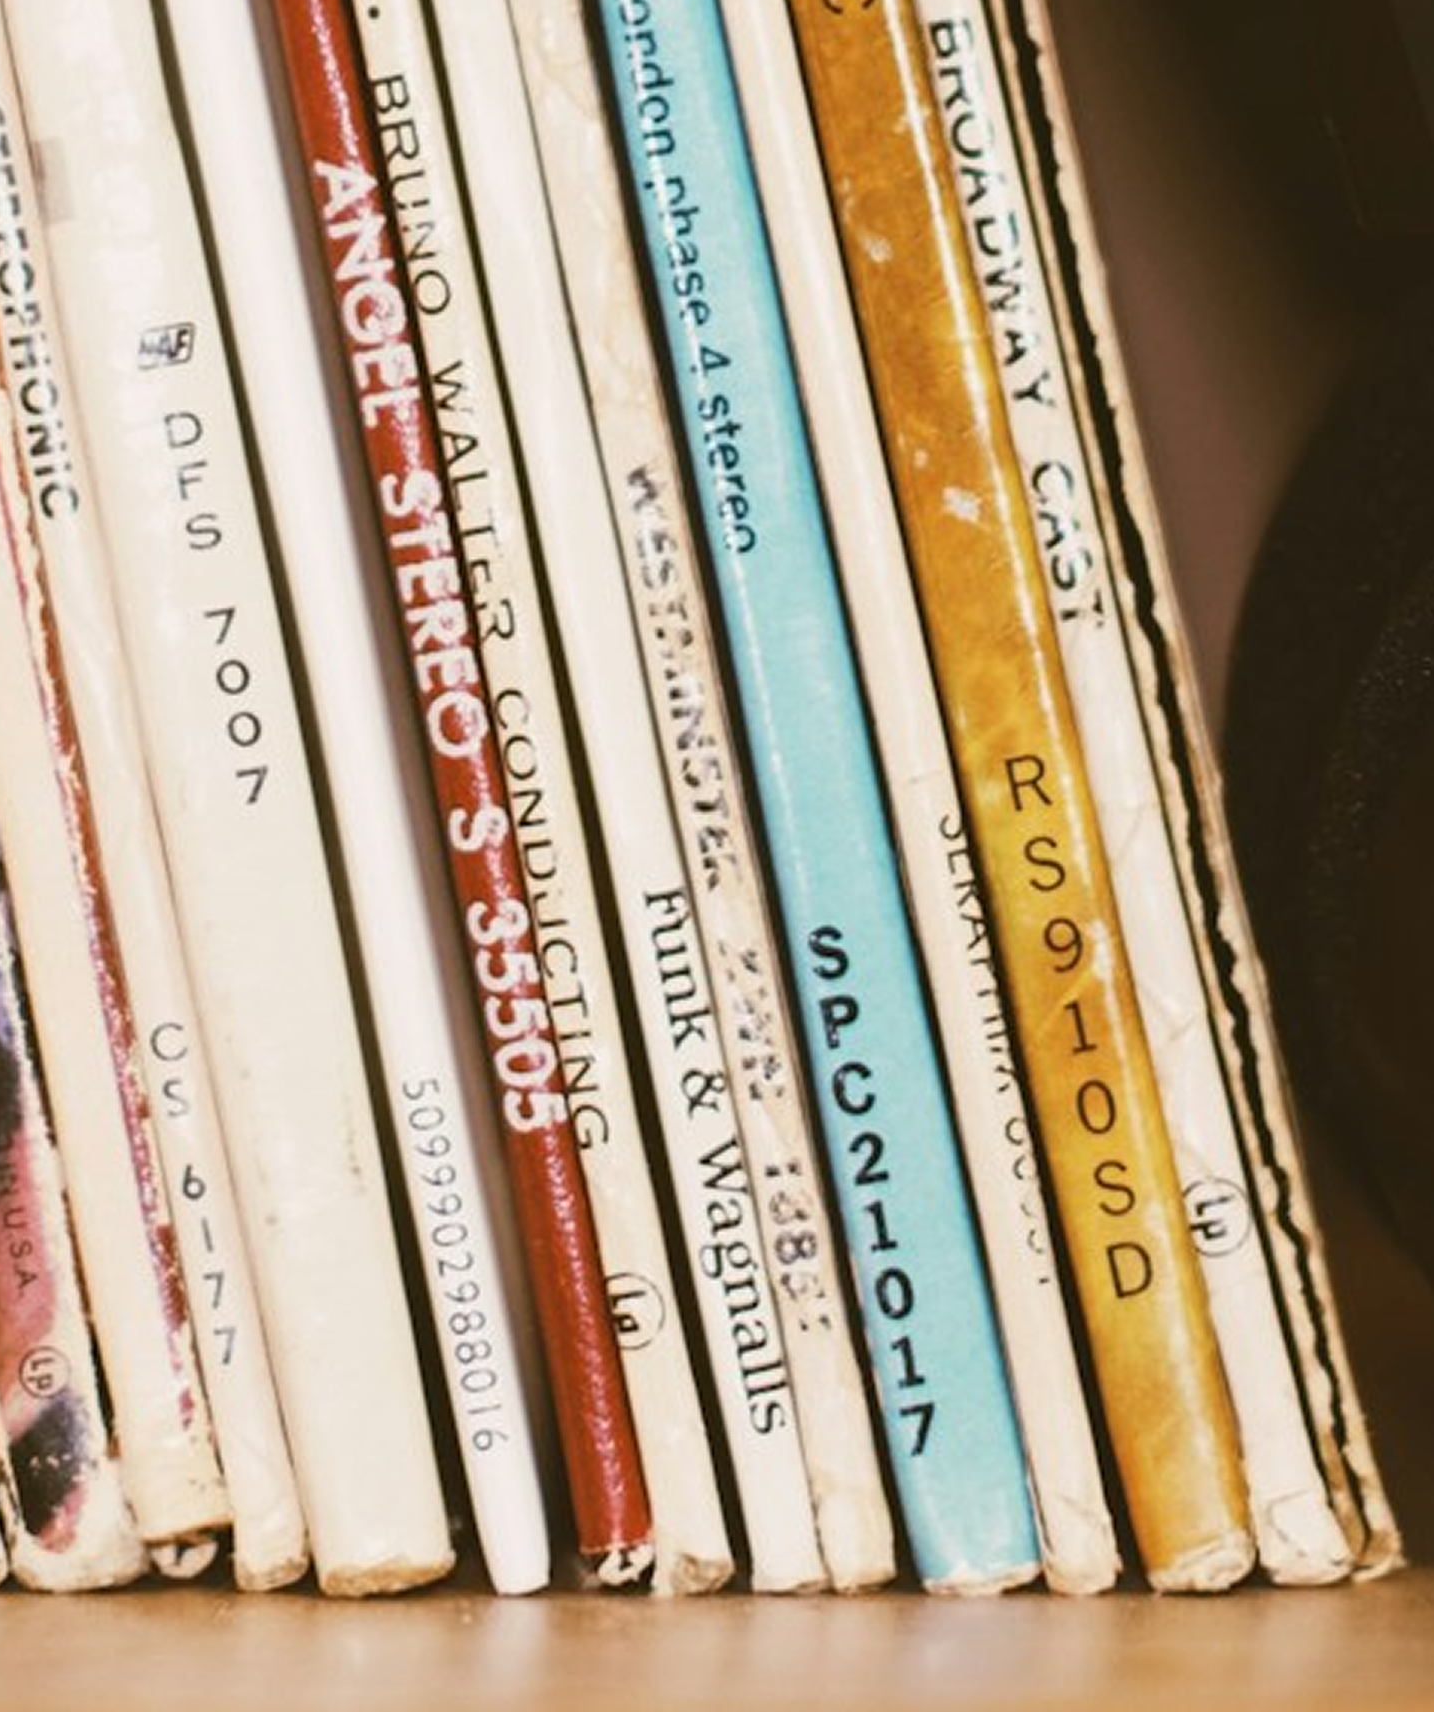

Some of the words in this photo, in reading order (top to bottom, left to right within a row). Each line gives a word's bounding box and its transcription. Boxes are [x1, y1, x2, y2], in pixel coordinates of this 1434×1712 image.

[313, 159, 422, 429] ANGEL
[642, 176, 710, 327] phase
[690, 345, 731, 378] 4
[695, 394, 758, 556] stereo
[1030, 461, 1107, 630] CAST
[367, 74, 451, 318] BRUNO
[428, 359, 515, 642] WALTER
[492, 688, 609, 1152] CONDUCTING
[378, 471, 490, 761] STEREO
[446, 807, 512, 854] S
[465, 899, 569, 1135] 35505
[643, 888, 707, 1051] Funk
[679, 1067, 726, 1118] &
[400, 1078, 509, 1452] 5099902988016
[697, 1136, 790, 1435] Wagnalls
